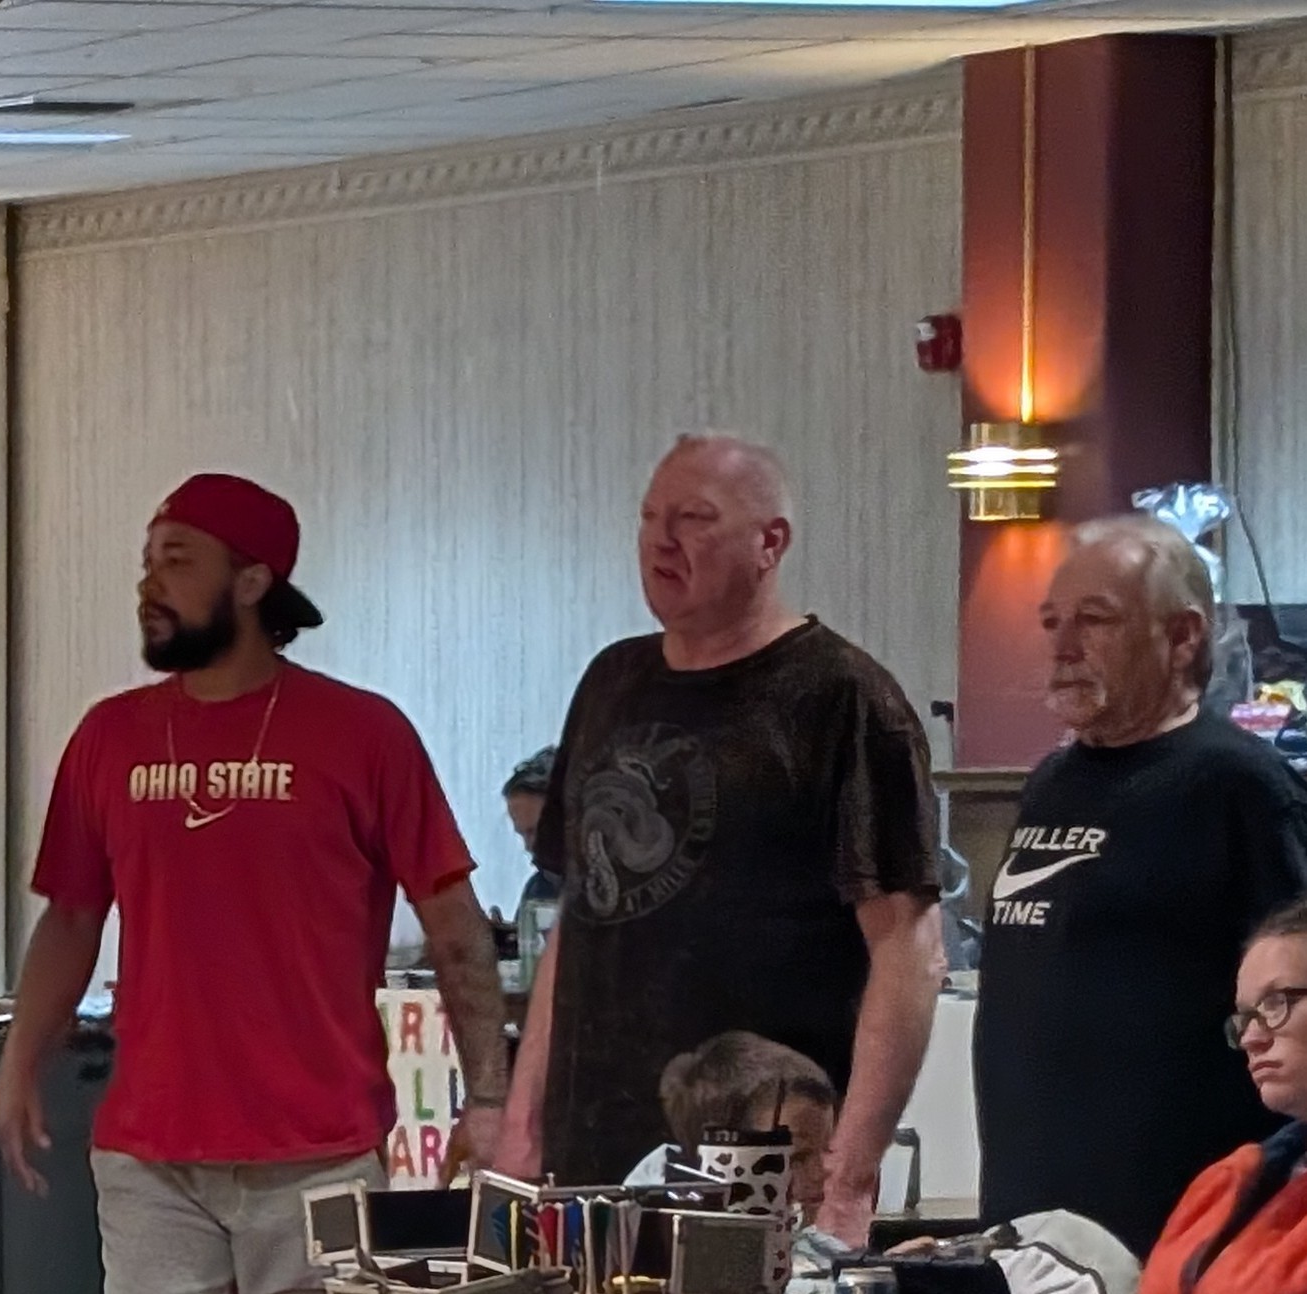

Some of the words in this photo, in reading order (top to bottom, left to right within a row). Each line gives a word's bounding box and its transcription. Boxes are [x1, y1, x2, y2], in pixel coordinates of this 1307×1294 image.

[129, 762, 198, 802] OHIO
[207, 761, 294, 801] STATE
[992, 900, 1051, 925] TIME
